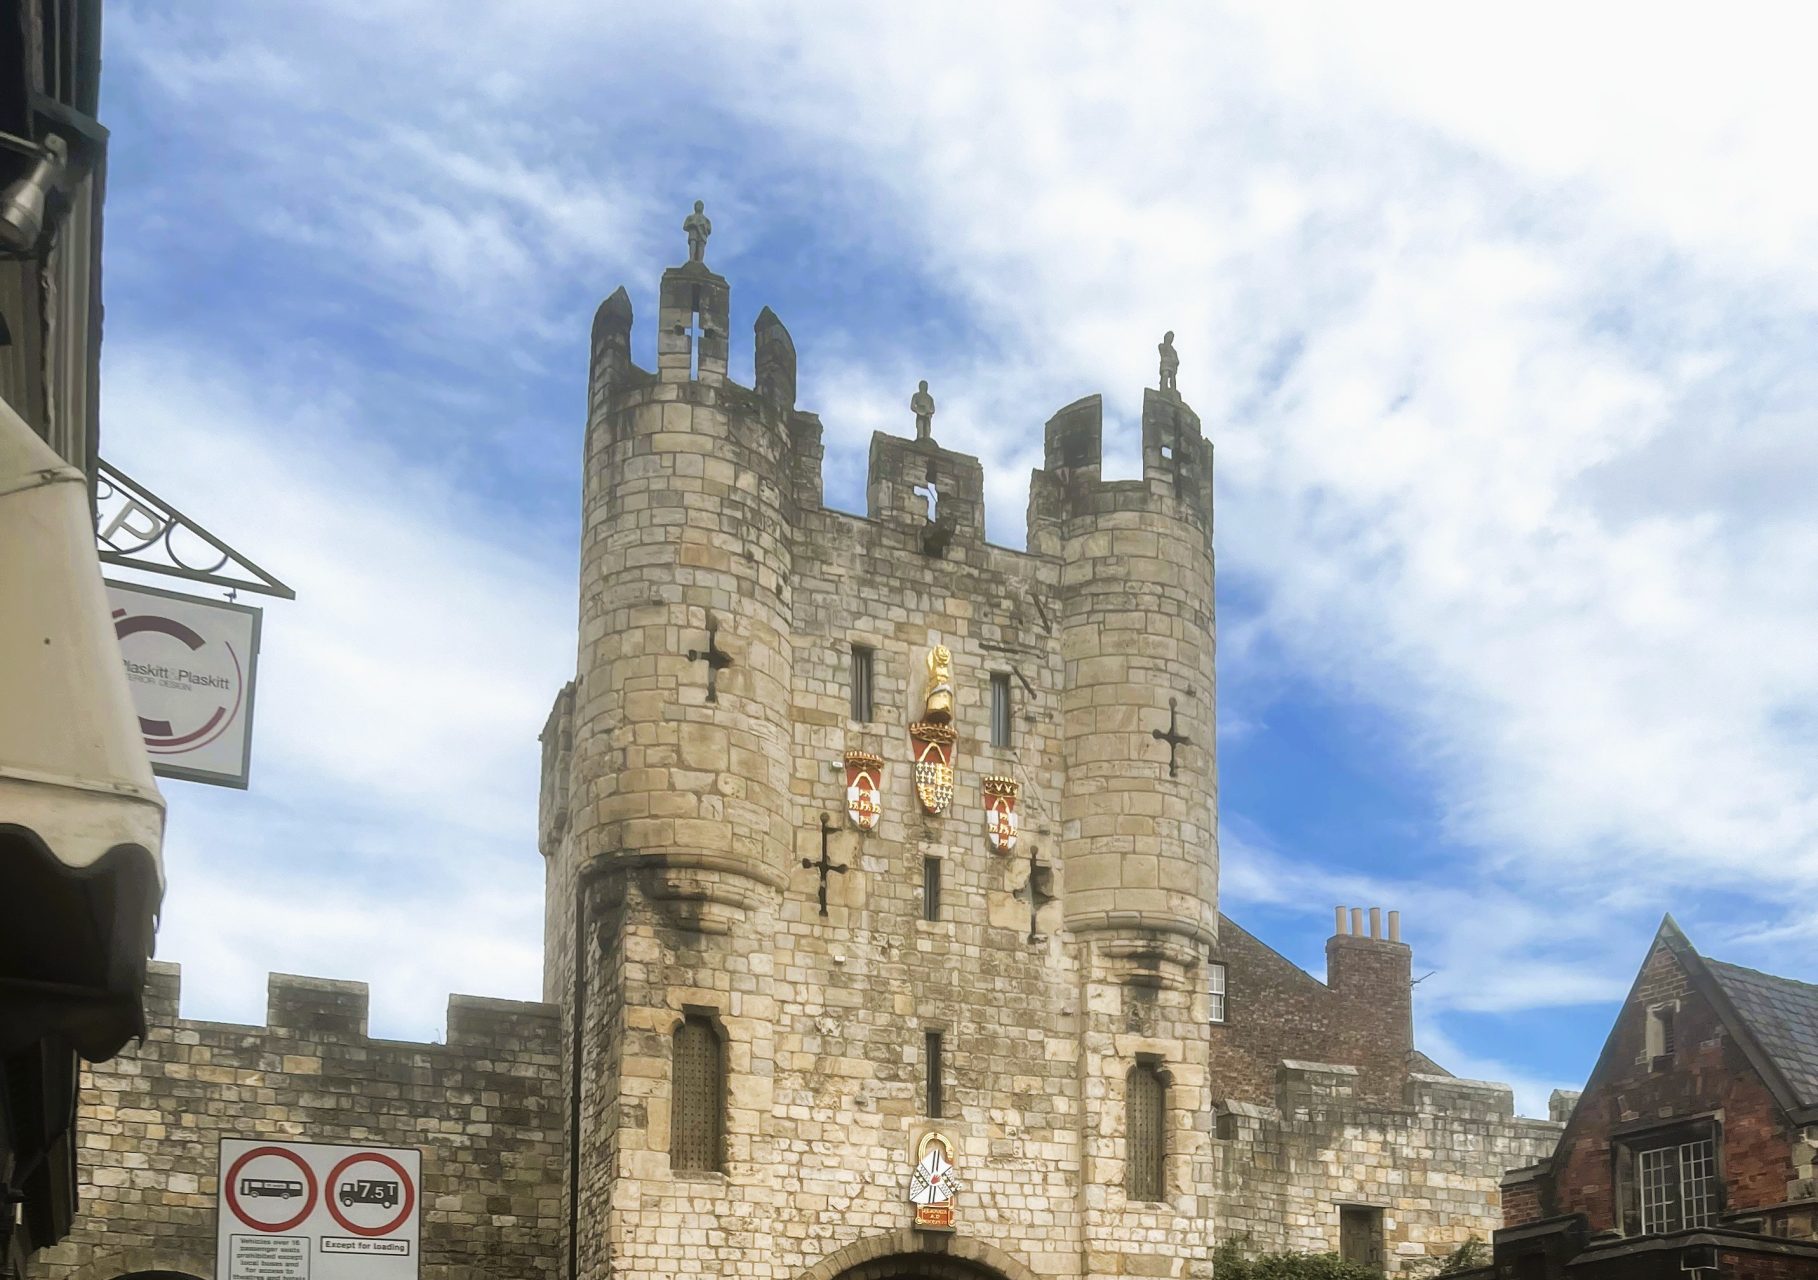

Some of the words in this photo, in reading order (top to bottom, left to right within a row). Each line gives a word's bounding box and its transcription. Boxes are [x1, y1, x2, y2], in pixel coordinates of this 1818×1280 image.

[178, 669, 230, 690] Plaskitt
[325, 1240, 356, 1251] Except
[358, 1241, 371, 1250] for
[373, 1242, 405, 1252] loading
